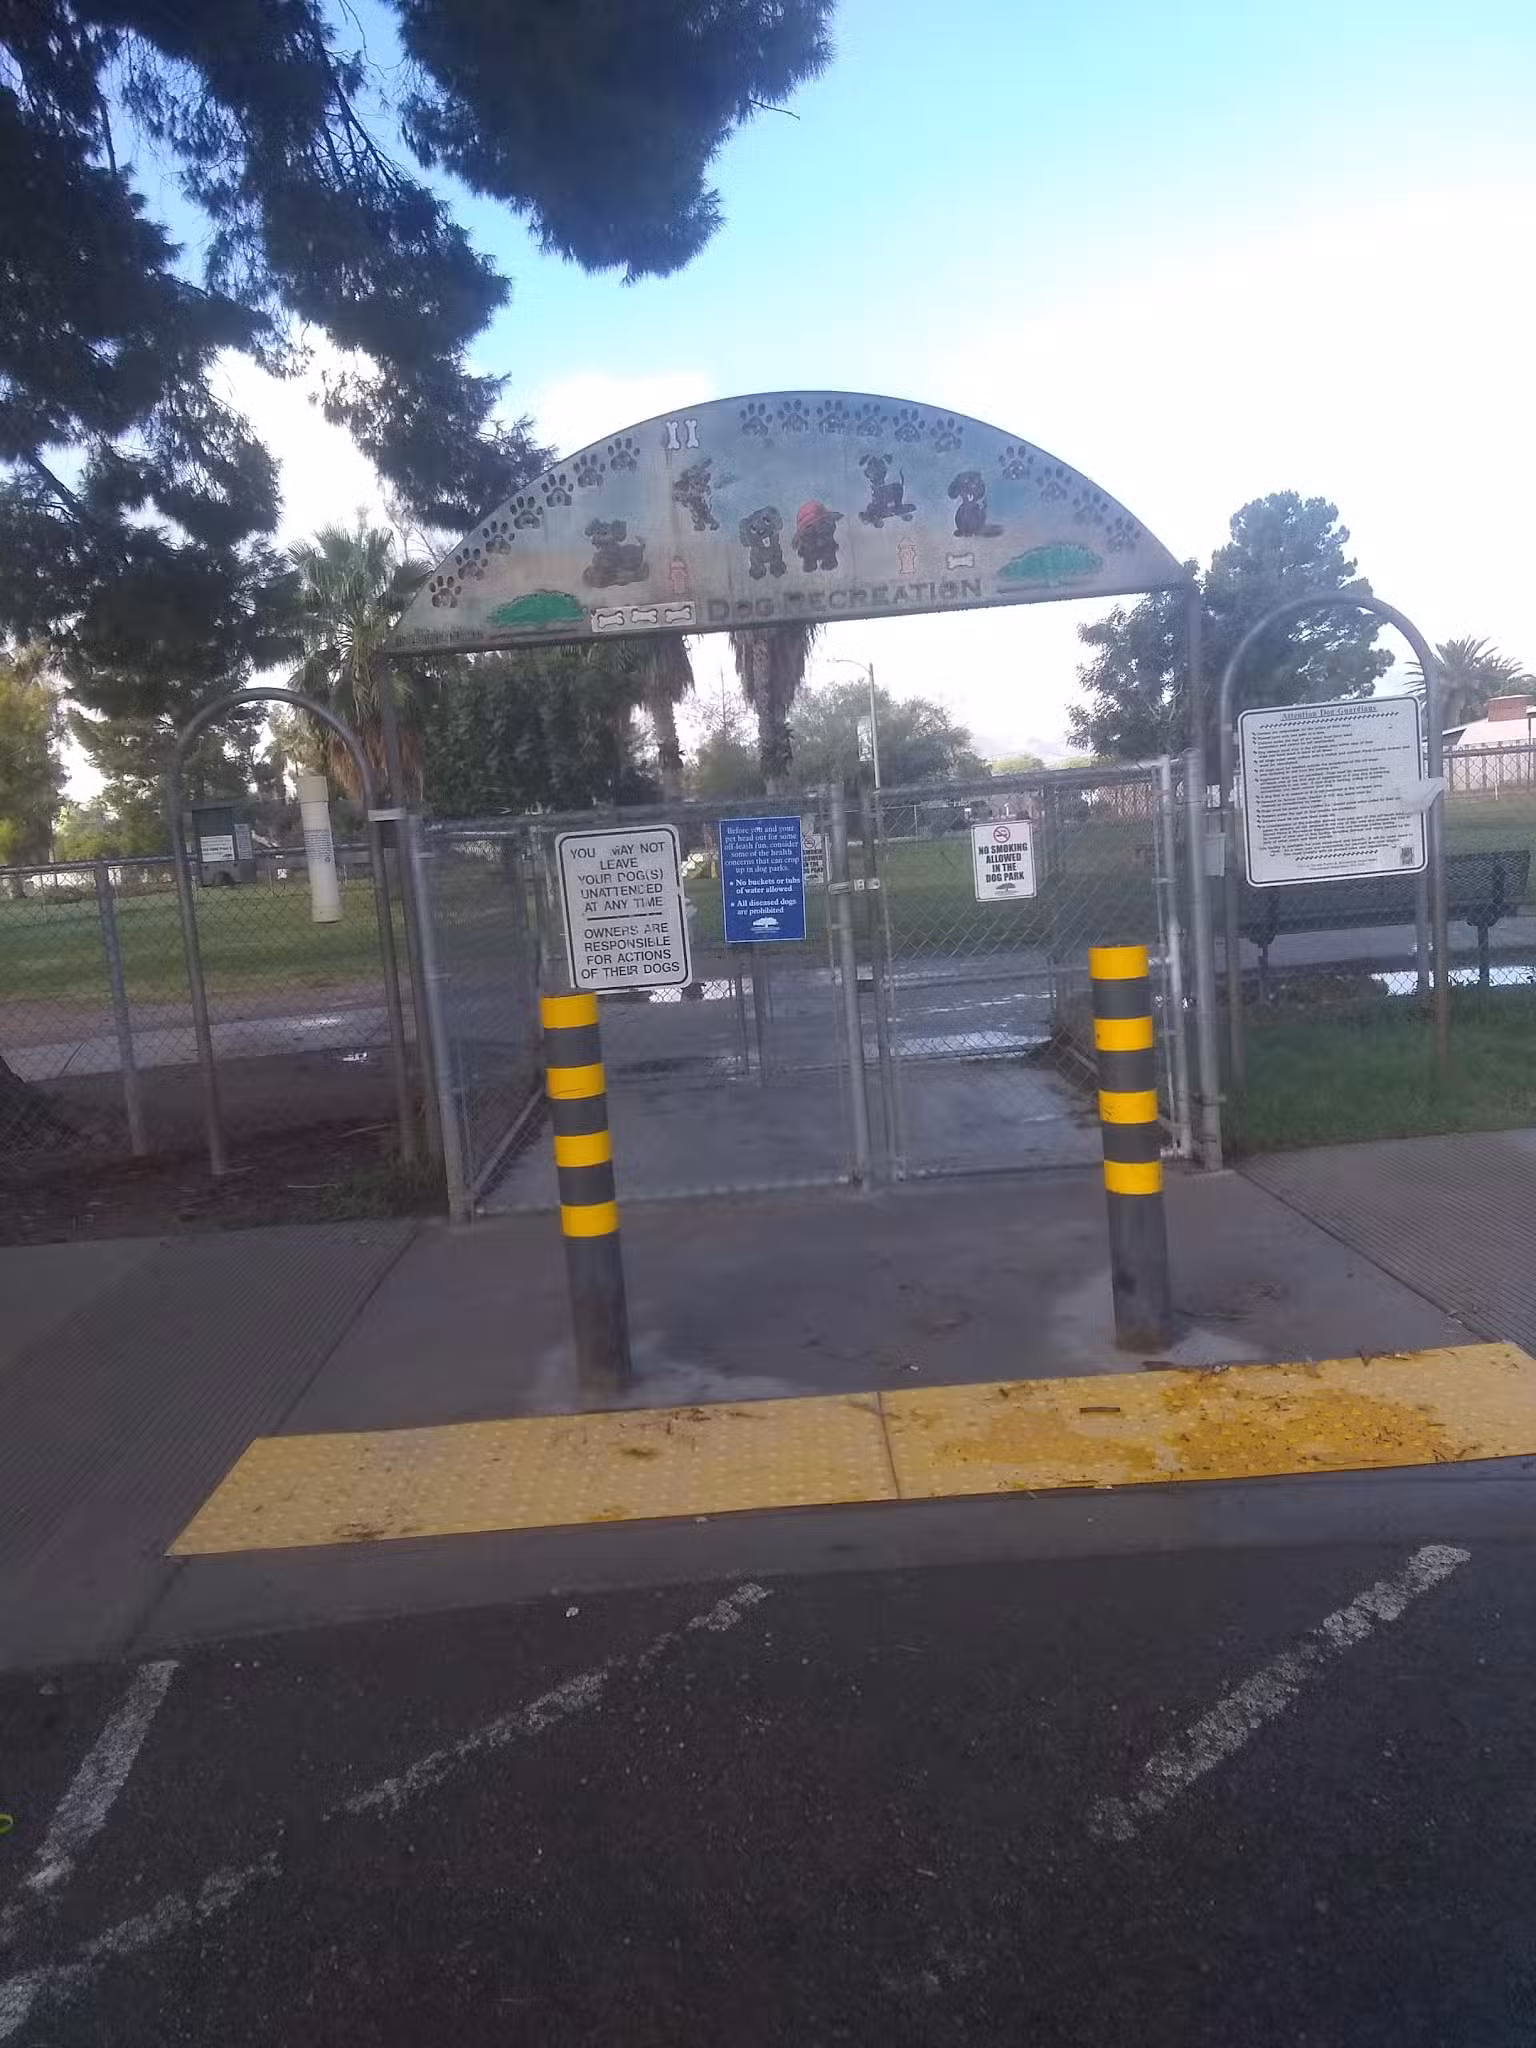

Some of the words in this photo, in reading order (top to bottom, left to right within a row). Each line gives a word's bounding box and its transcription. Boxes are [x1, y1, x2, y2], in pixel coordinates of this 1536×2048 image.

[782, 578, 982, 613] RECREATION
[1282, 710, 1317, 720] Attention
[1338, 706, 1377, 714] Guardians
[570, 848, 596, 859] YOU
[611, 844, 634, 856] MAY
[640, 842, 665, 853] NOT
[770, 840, 798, 848] consider
[978, 846, 989, 855] NO
[991, 843, 1028, 854] SMOKING
[600, 858, 638, 870] LEAVE
[986, 853, 1021, 864] ALLOWED
[992, 864, 1000, 872] IN
[1002, 863, 1017, 871] THE
[578, 873, 612, 885] YOUR
[617, 868, 663, 882] DOG(S)
[986, 873, 1002, 882] DOG
[1004, 872, 1024, 881] PARK
[581, 883, 663, 899] UNATTENDED
[766, 885, 793, 893] allowed
[585, 901, 598, 913] AT
[604, 900, 628, 911] ANY
[634, 896, 664, 907] TIME
[750, 906, 784, 915] prohibited
[584, 926, 638, 939] OWNERS
[644, 923, 669, 934] ARE
[585, 936, 671, 952] RESPONSIBLE
[587, 954, 612, 965] FOR
[618, 949, 671, 962] ACTIONS
[581, 969, 598, 979] OF
[603, 966, 638, 977] THEIR
[644, 962, 680, 974] DOGS
